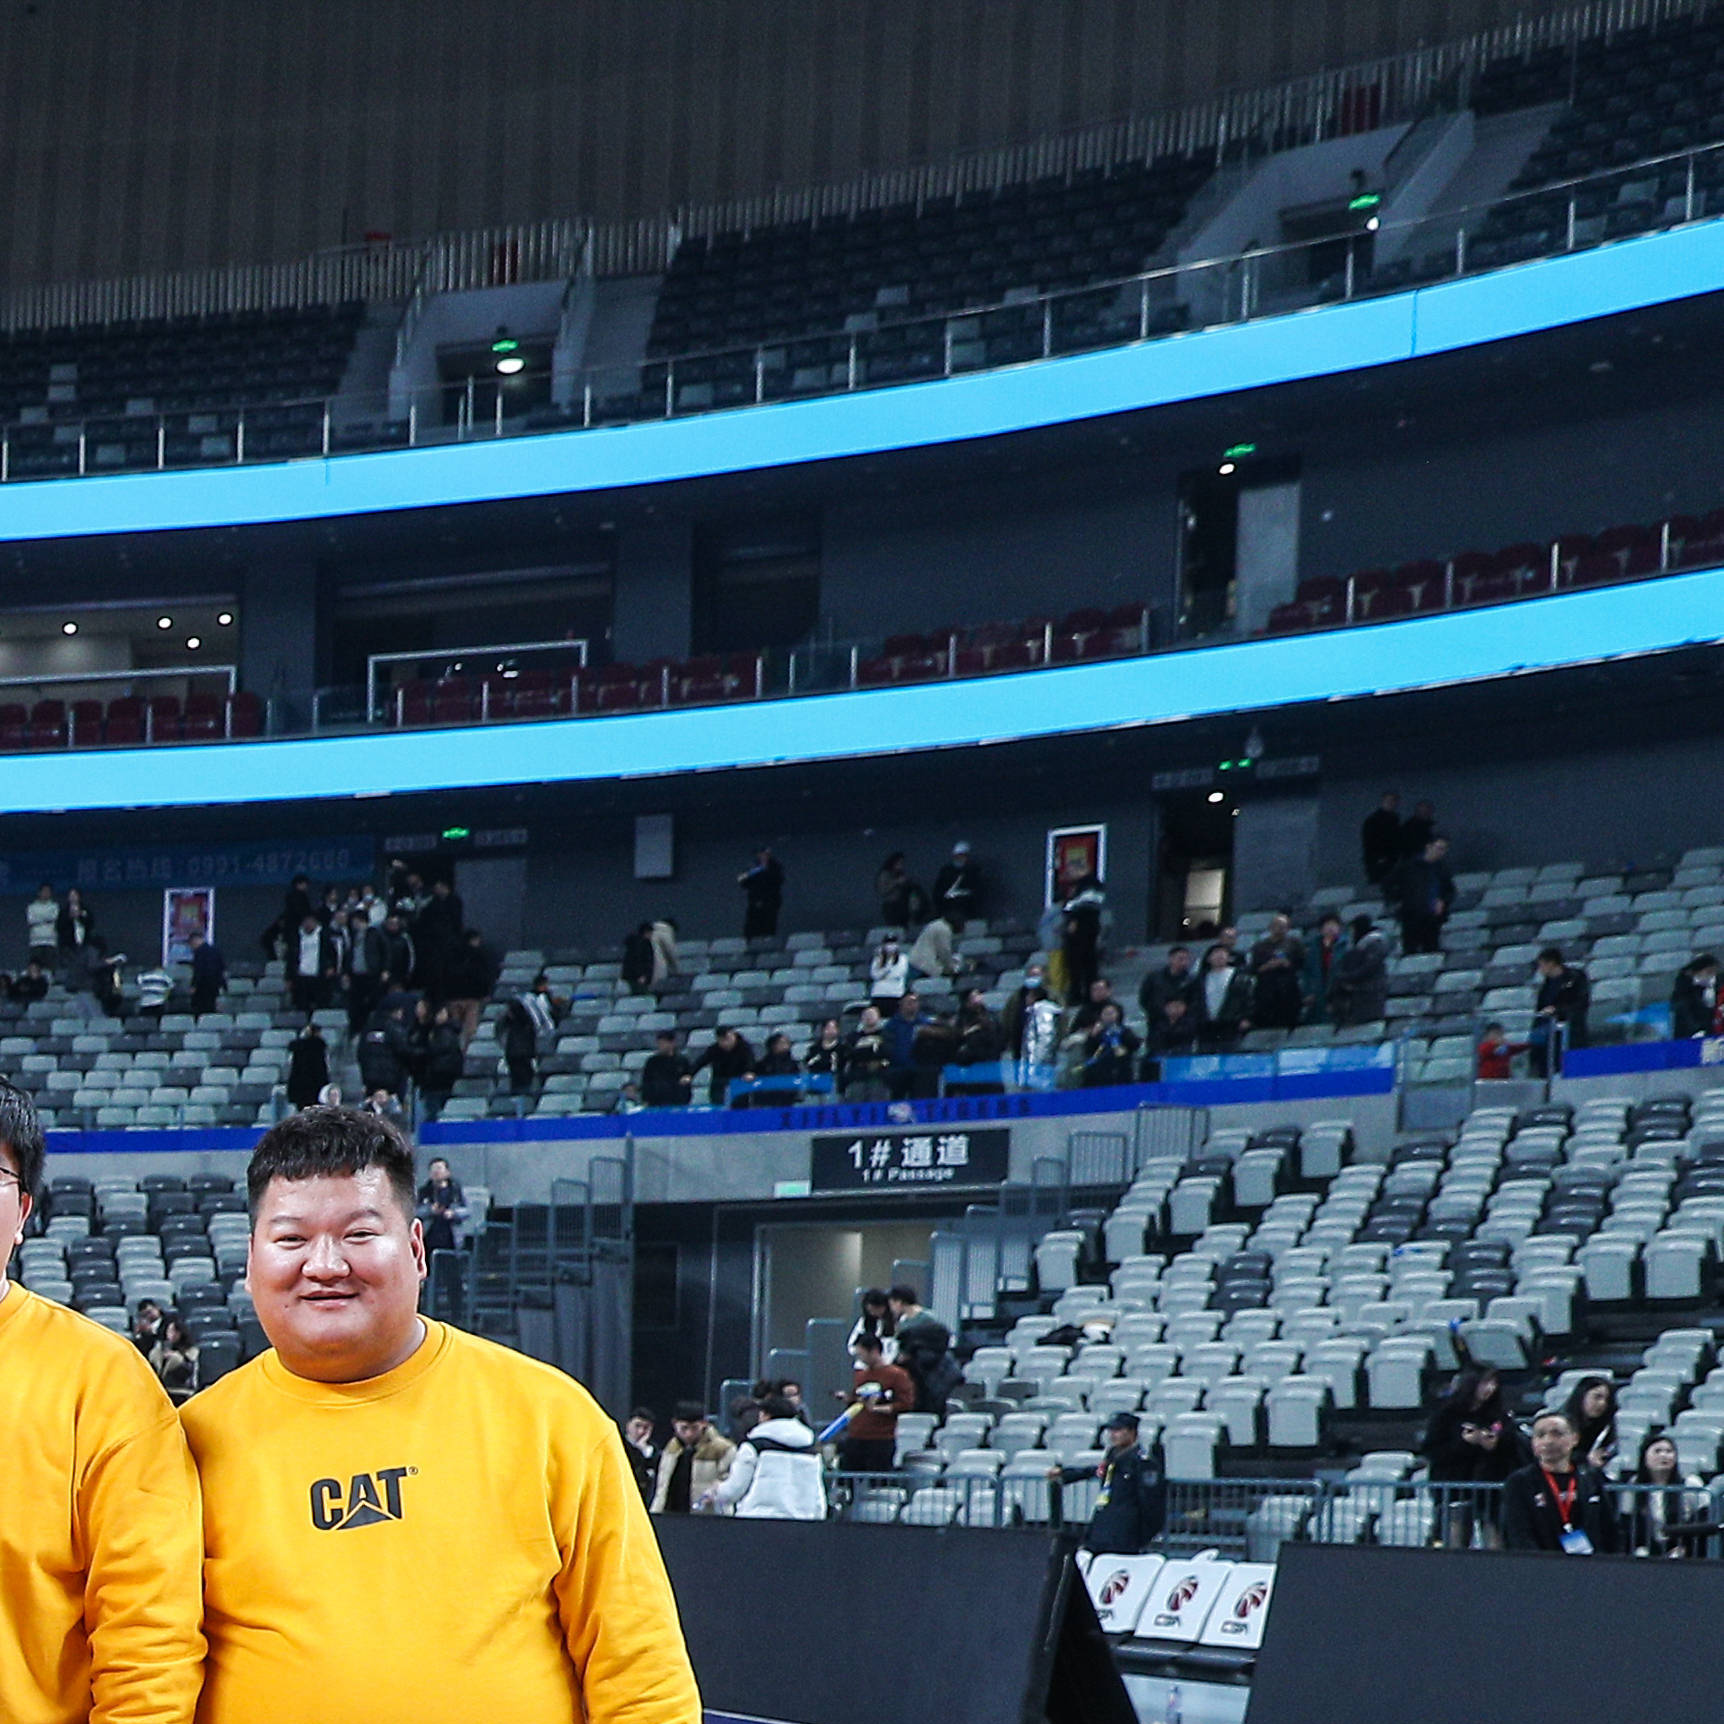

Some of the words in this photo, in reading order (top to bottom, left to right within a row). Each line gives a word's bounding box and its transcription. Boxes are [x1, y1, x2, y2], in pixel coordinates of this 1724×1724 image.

[848, 1141, 892, 1168] 1#
[901, 1134, 970, 1168] 通道
[888, 1166, 956, 1183] Passage
[310, 1467, 408, 1531] CAT
